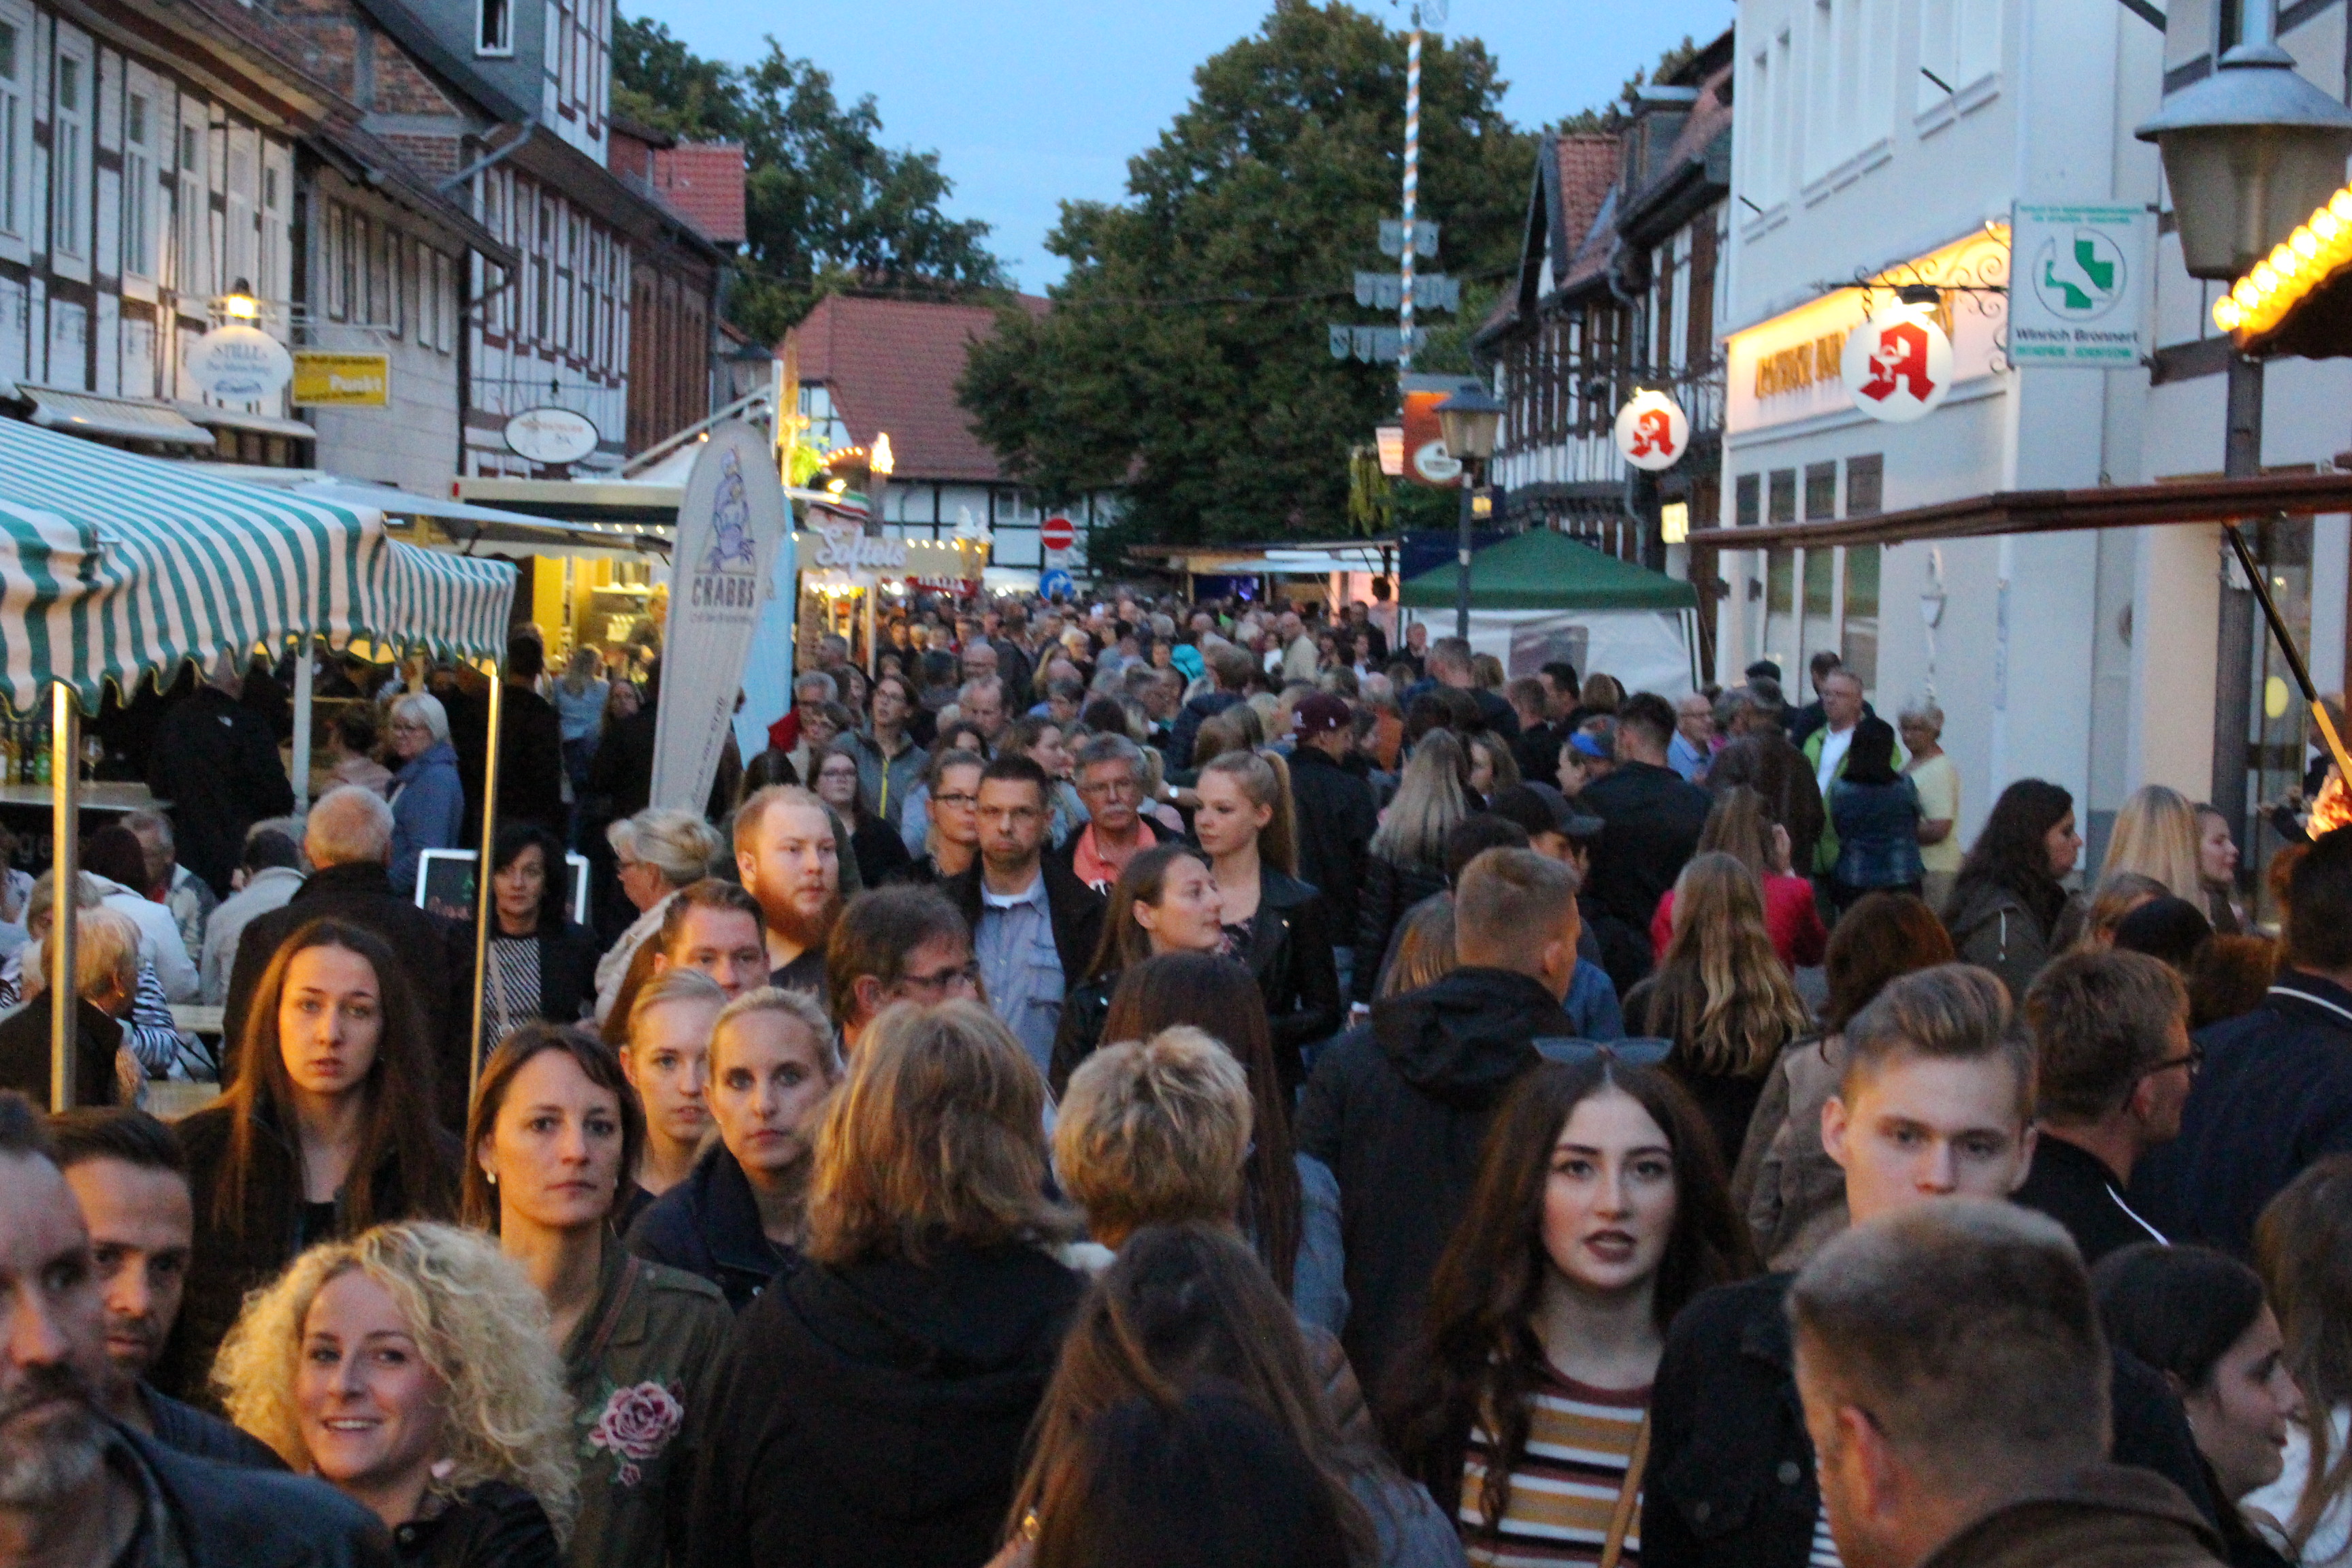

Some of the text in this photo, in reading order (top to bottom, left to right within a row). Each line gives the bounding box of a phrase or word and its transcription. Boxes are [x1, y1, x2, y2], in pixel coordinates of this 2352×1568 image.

[329, 374, 382, 391] Punkt
[815, 525, 906, 579] Softeis
[691, 576, 755, 608] CRABBS
